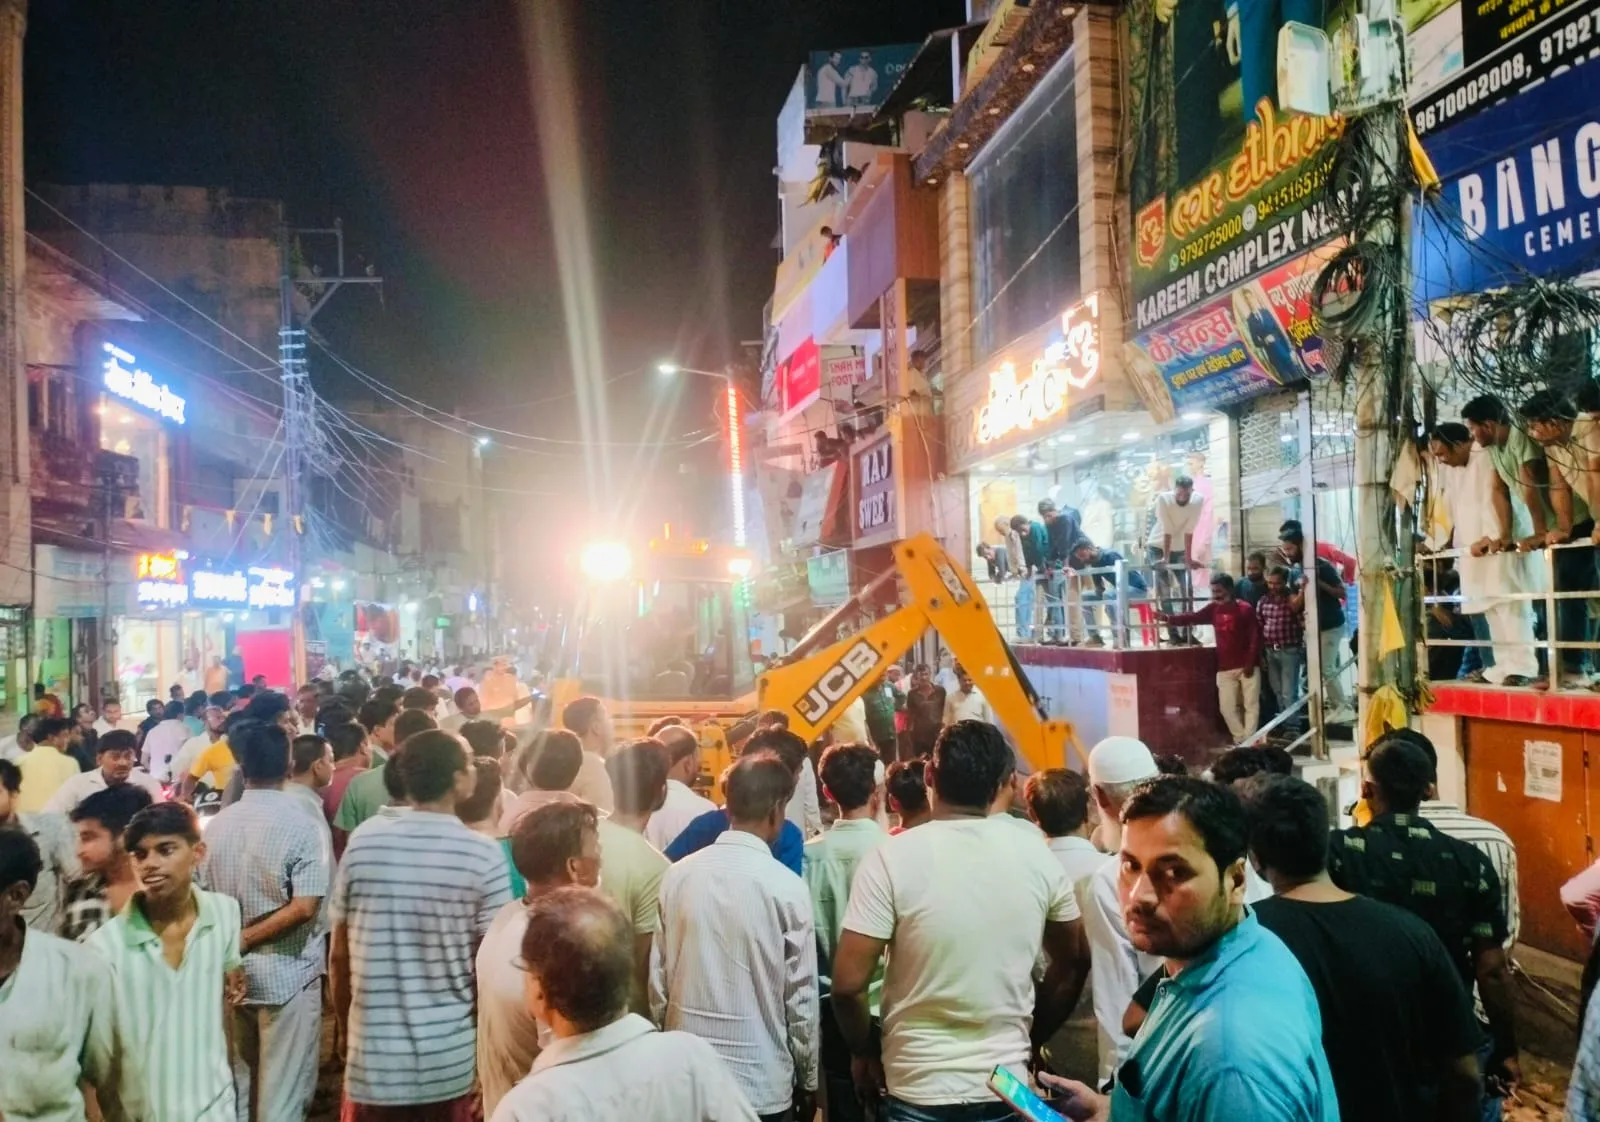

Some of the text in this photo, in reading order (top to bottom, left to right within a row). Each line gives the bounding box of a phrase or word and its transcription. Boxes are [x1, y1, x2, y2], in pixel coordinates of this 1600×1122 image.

[1415, 52, 1532, 135] 9670002008,
[1137, 269, 1200, 330] KAREEM
[1205, 217, 1296, 294] COMPLEX
[1180, 215, 1243, 266] 9792725000
[805, 642, 879, 722] JCB
